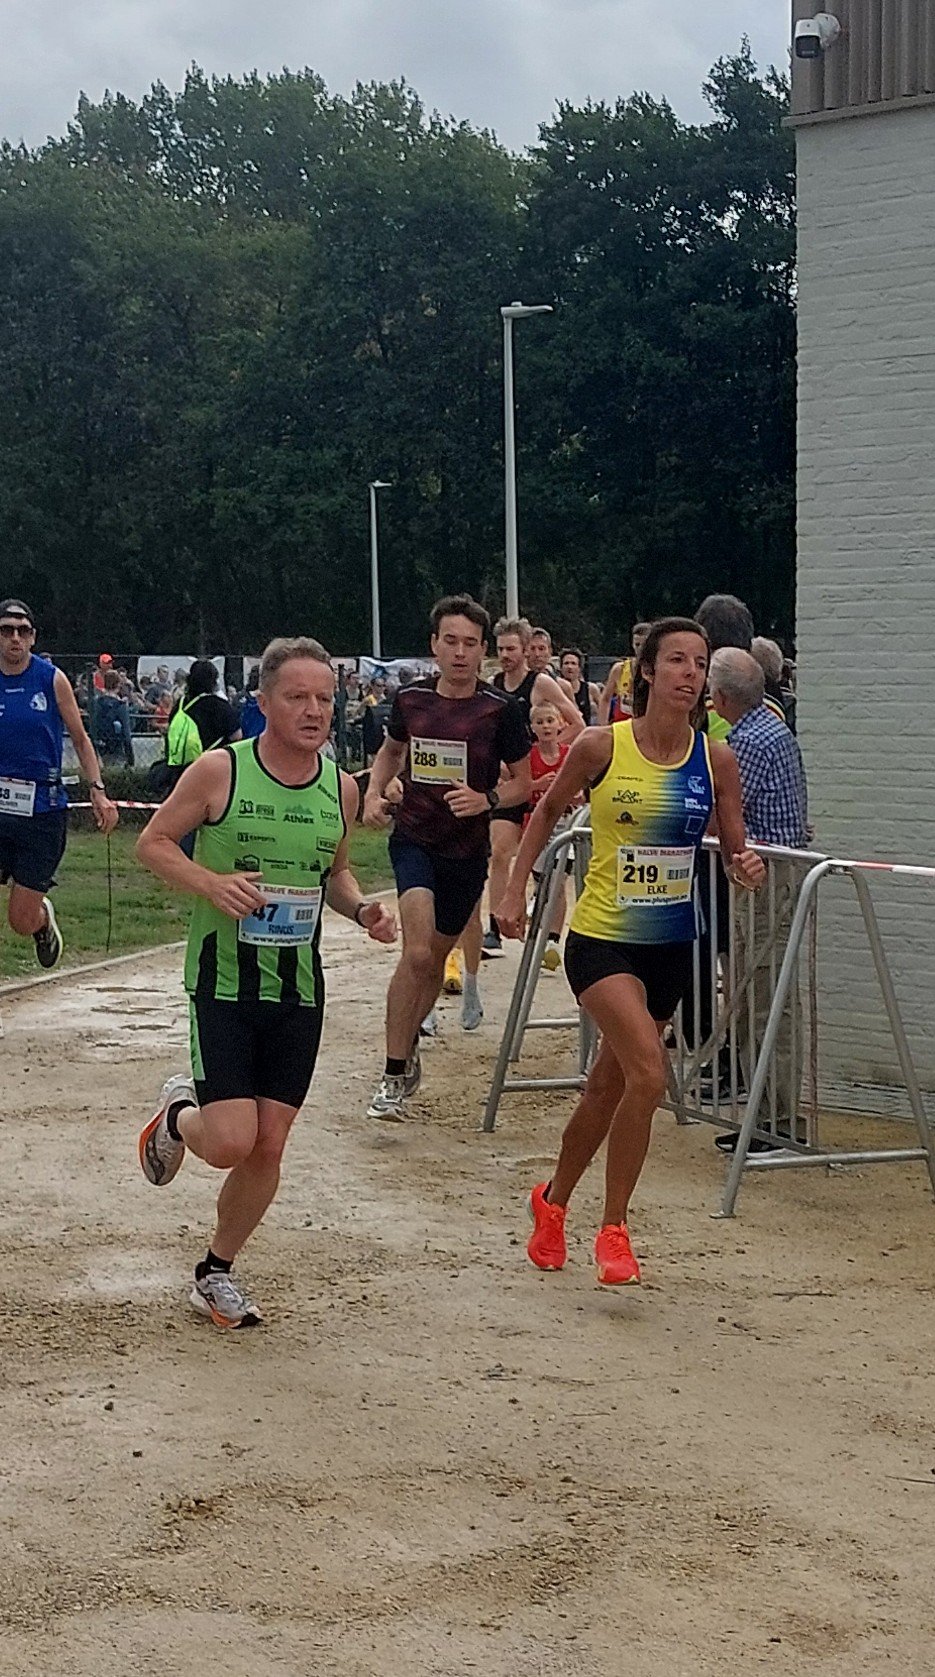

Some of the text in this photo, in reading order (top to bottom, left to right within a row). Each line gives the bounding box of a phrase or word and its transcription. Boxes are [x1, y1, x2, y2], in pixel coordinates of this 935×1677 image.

[413, 751, 438, 767] 288
[283, 813, 315, 824] Athlex
[622, 864, 658, 884] 219
[647, 884, 668, 895] ELKE
